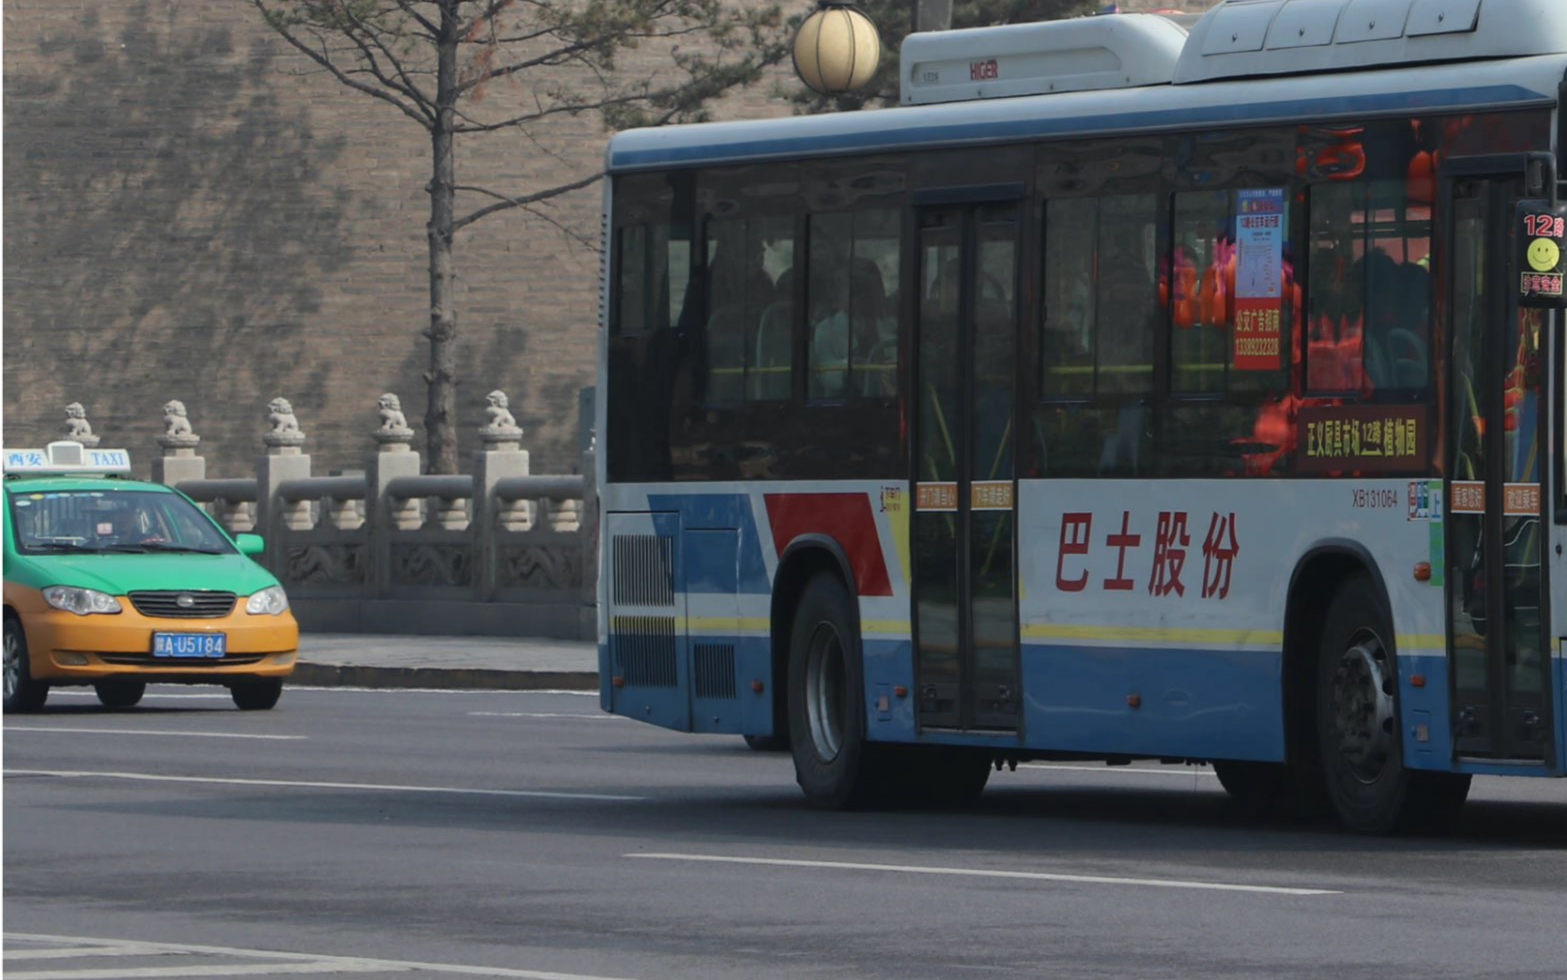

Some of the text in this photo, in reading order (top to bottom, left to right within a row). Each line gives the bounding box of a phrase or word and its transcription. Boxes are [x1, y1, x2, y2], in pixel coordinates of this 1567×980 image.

[969, 59, 999, 81] HIGER
[1524, 214, 1564, 238] 12路
[1235, 307, 1280, 332] 公交广告招商
[1307, 418, 1361, 458] 正义厨具市场
[1383, 418, 1416, 458] 植物园
[9, 452, 125, 467] 西安 TAXI
[1352, 489, 1398, 508] XB131064
[1055, 510, 1240, 600] 巴士股份
